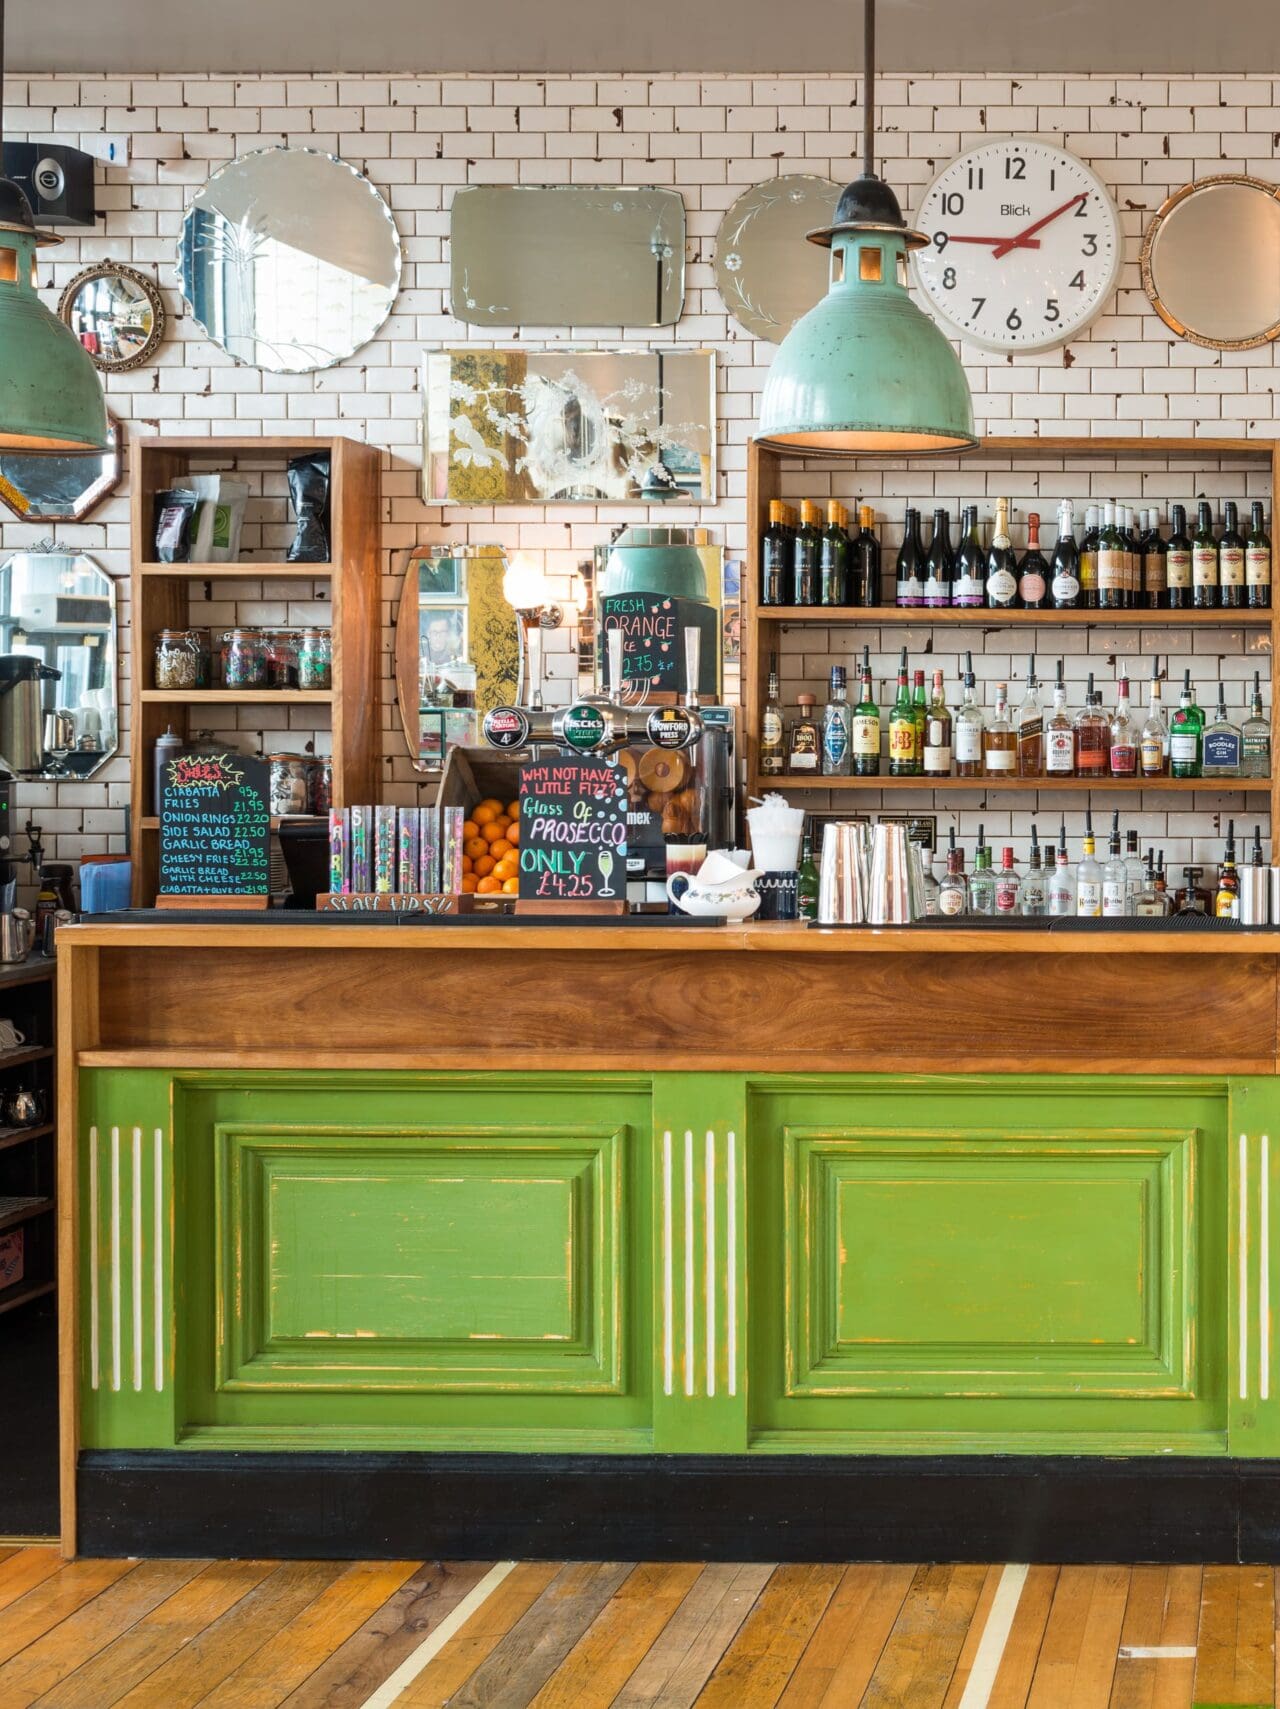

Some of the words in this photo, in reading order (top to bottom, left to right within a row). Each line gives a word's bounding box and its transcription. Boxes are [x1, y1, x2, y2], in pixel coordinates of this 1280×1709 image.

[968, 168, 984, 190] 11
[1005, 157, 1026, 180] 12
[1050, 169, 1055, 191] 1
[941, 193, 964, 215] 10
[1000, 204, 1031, 216] Blick
[1074, 194, 1088, 217] 2
[933, 231, 949, 254] 9
[1081, 234, 1098, 256] 3
[942, 267, 957, 289] 8
[1069, 270, 1087, 291] 4
[971, 298, 987, 319] 7
[1006, 308, 1022, 330] 6
[1044, 299, 1060, 321] 5
[606, 599, 645, 613] FRESH
[605, 615, 675, 638] ORANGE
[522, 768, 548, 781] WHY
[553, 767, 578, 780] NOT
[581, 768, 614, 782] HAVE
[164, 787, 220, 797] CIABATTA
[239, 786, 258, 800] 95p
[520, 784, 529, 794] A
[535, 782, 572, 794] LITTLE
[579, 782, 617, 796] FIZZ?
[164, 799, 199, 808] FRIES
[233, 800, 264, 811] £1.95
[523, 797, 563, 818] Glass
[573, 801, 592, 826] Of
[163, 811, 200, 822] ONION
[202, 814, 236, 824] RINGS
[162, 825, 189, 836] SIDE
[193, 827, 230, 837] SALAD
[234, 826, 265, 838] £2.50
[530, 818, 626, 845] PROSECCO
[163, 839, 208, 850] GARLIC
[211, 839, 250, 850] BREAD
[162, 854, 203, 863] CHEESY
[206, 855, 236, 864] FRIES
[520, 848, 587, 874] ONLY
[162, 865, 196, 874] GARLIC
[198, 867, 229, 875] BREAD
[200, 875, 242, 883] CHEESE
[160, 885, 204, 893] CIABATTA
[536, 870, 593, 897] £4.25
